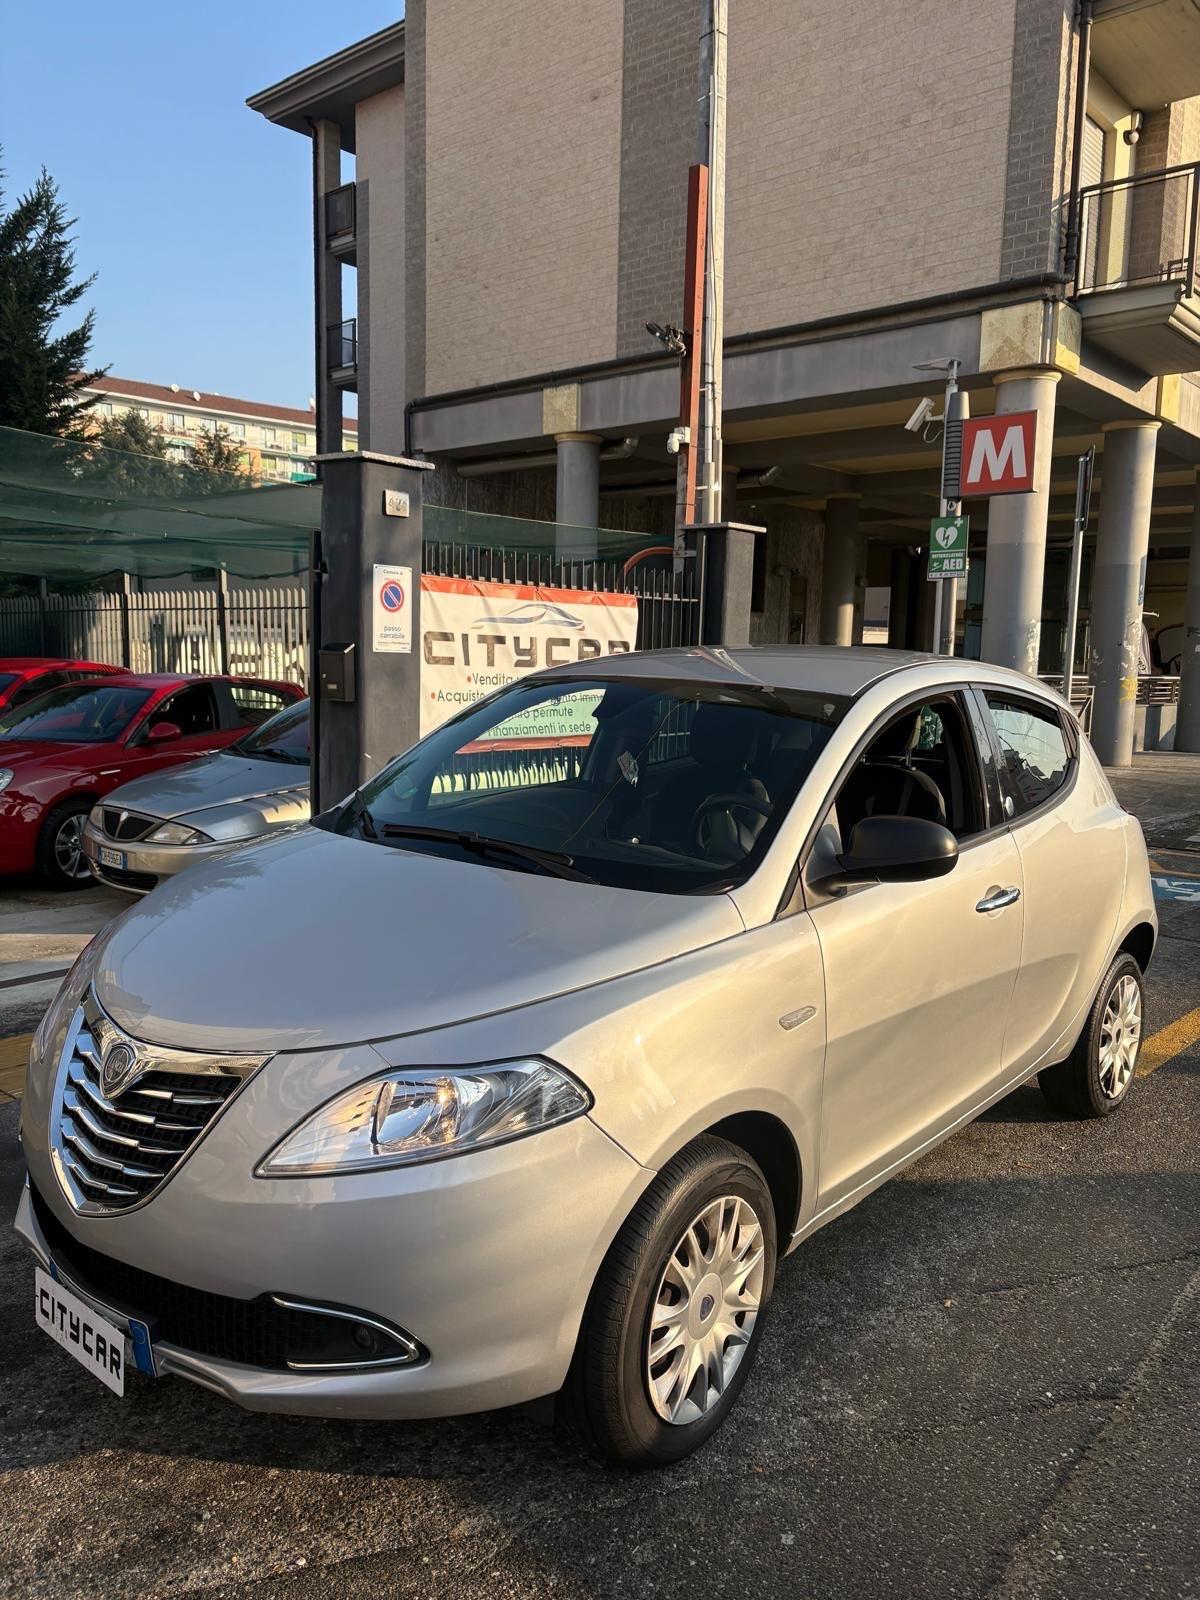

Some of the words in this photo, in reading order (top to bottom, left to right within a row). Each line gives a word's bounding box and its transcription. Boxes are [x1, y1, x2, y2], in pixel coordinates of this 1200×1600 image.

[966, 425, 1027, 483] M
[942, 559, 963, 570] AED
[472, 673, 514, 686] Vendita
[532, 707, 573, 721] permute
[558, 722, 568, 734] in
[569, 721, 591, 733] sede
[40, 1287, 121, 1380] CITYCAR
